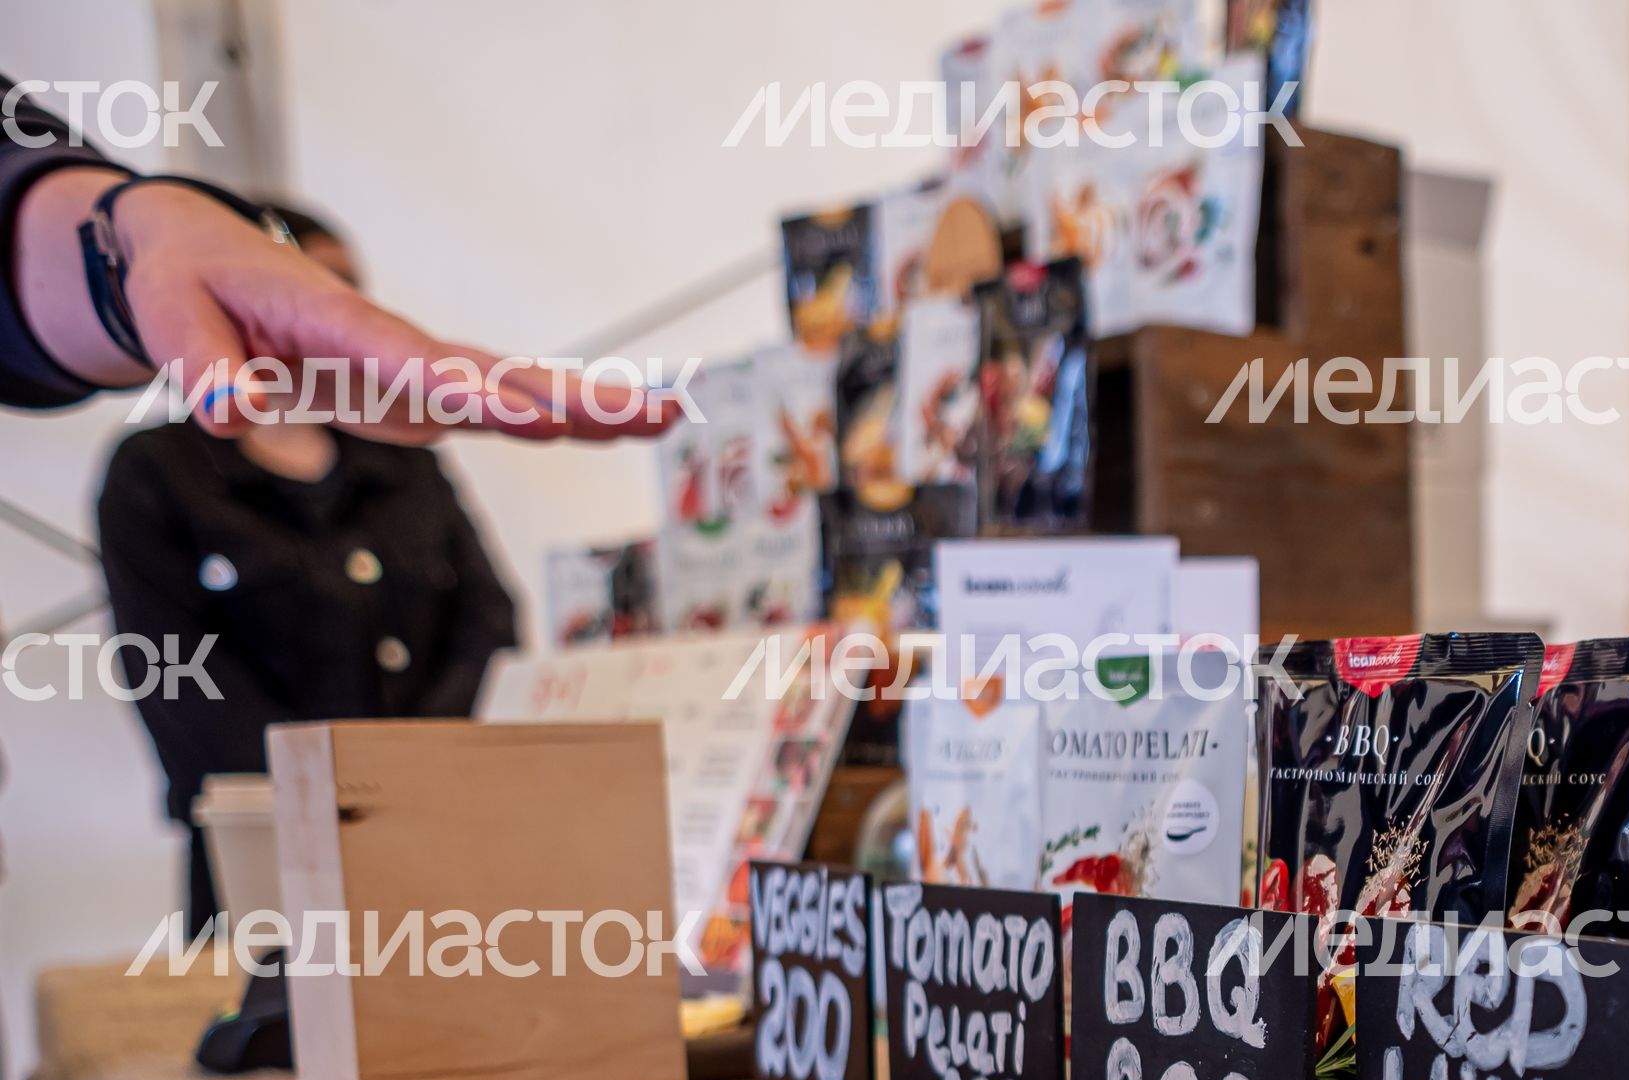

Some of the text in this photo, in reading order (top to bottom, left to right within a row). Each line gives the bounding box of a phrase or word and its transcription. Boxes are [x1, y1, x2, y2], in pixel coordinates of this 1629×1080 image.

[1349, 646, 1404, 668] icancook
[1050, 728, 1209, 760] OMATO PELATI
[1333, 724, 1391, 766] BBQ
[1270, 768, 1409, 786] ГАСТРОНОМИЧЕСКИЙ
[1568, 772, 1607, 786] СОУС
[1104, 909, 1266, 1048] BBQ
